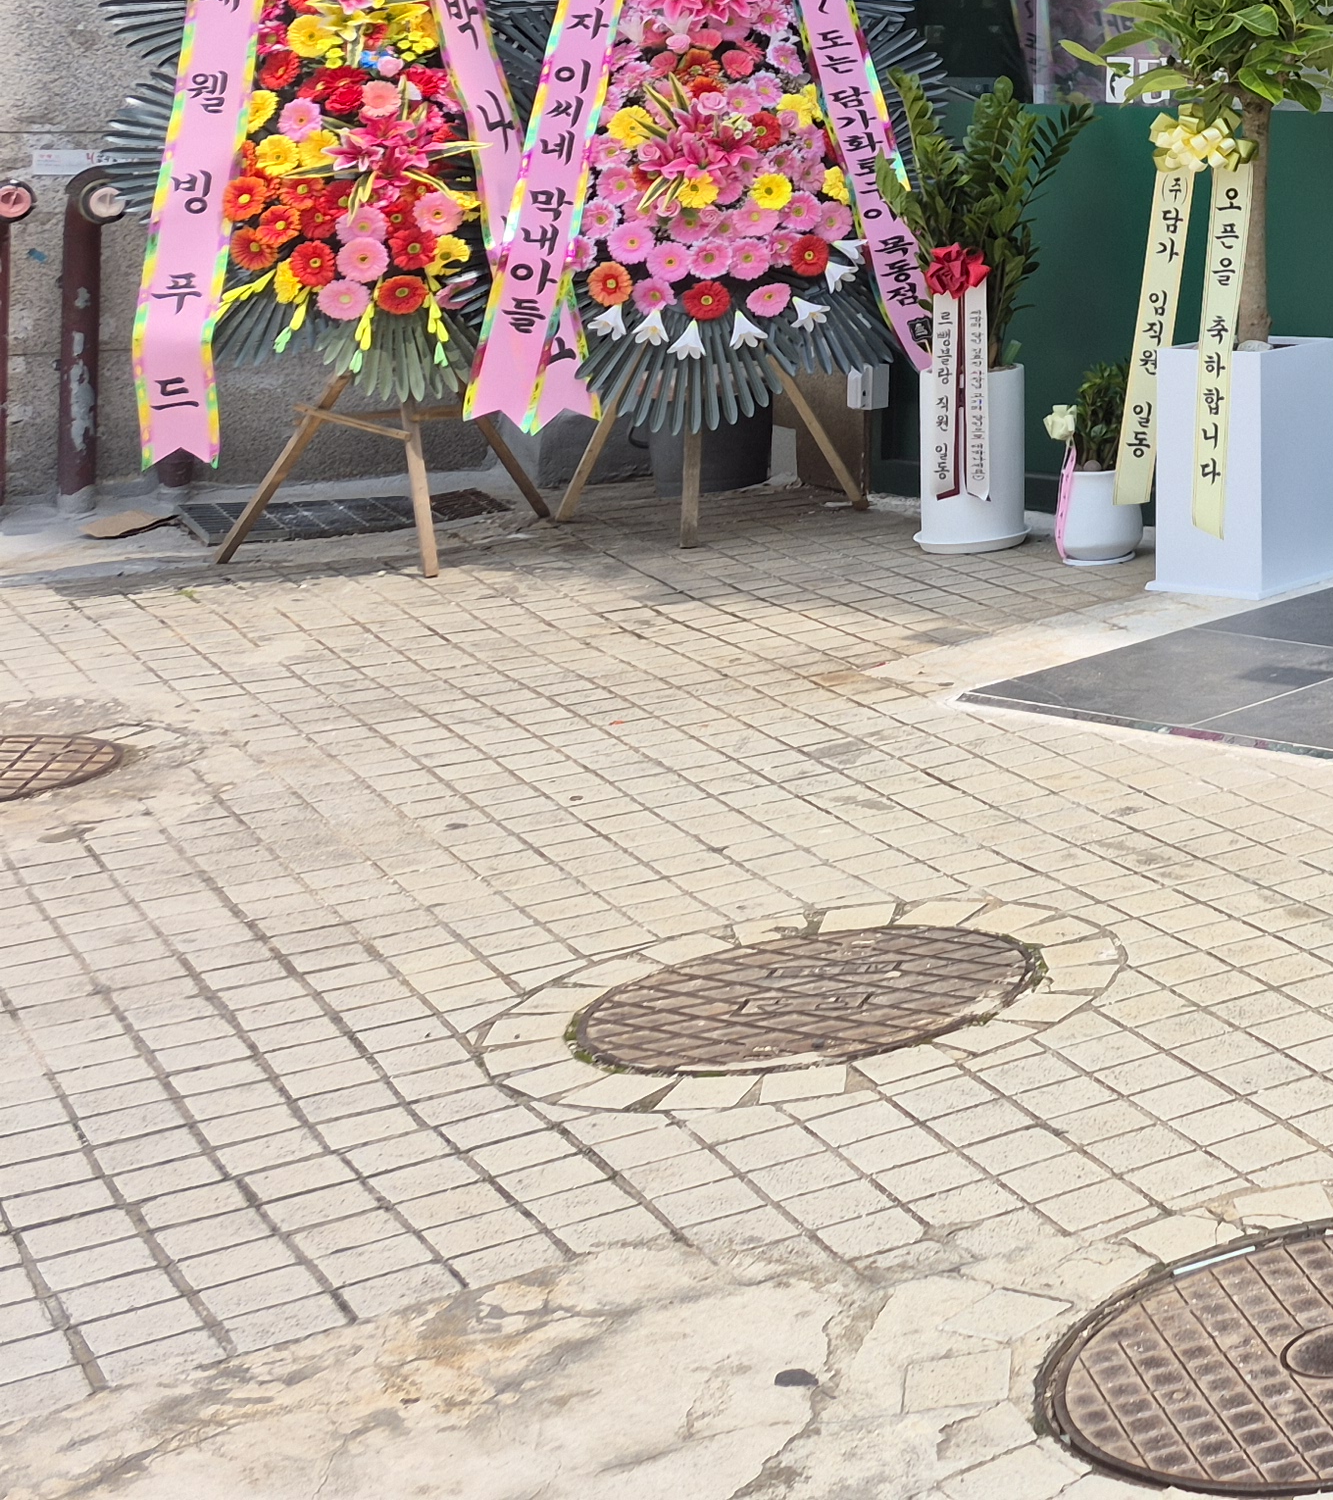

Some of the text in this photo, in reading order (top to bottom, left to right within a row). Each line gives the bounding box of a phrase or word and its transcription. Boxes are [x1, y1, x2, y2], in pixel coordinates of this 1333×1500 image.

[537, 58, 595, 166] 이씨네
[816, 28, 858, 75] 도는
[874, 234, 920, 308] 목동점
[501, 187, 574, 334] 막내아들
[1139, 289, 1168, 377] 임직원
[1199, 186, 1244, 487] 오픈을 축하합니다
[1126, 400, 1155, 460] 일동
